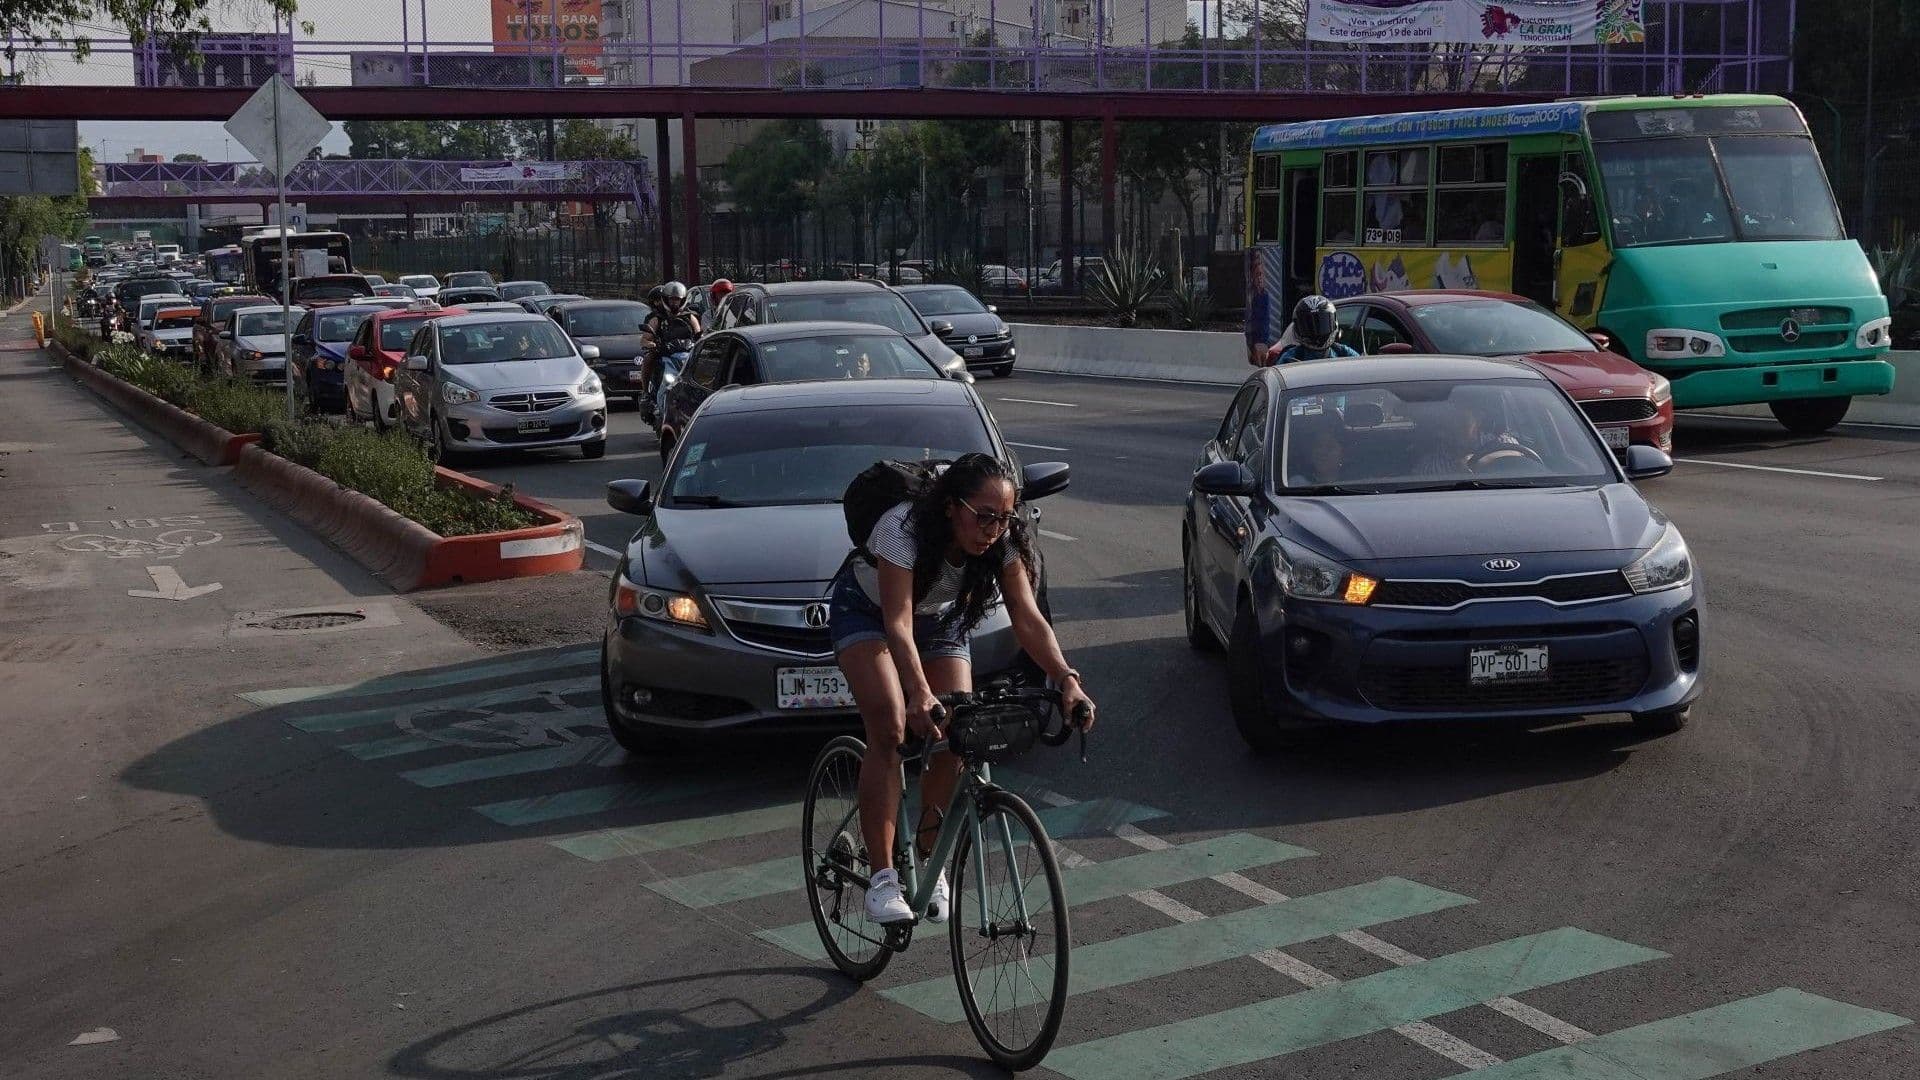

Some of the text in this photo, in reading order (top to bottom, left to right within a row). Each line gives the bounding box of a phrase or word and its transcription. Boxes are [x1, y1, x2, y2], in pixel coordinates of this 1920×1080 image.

[562, 14, 598, 24] PARA
[507, 23, 599, 40] TODOS
[1330, 27, 1432, 38] Este domingo 19 de abril
[1520, 24, 1572, 34] LA GRAN
[1454, 116, 1476, 129] PRICE
[1480, 114, 1507, 127] SHOES
[1507, 108, 1560, 127] KangaROOS
[1322, 255, 1363, 278] Price
[1489, 559, 1515, 568] KIA
[1471, 652, 1547, 673] PVP-601-C
[780, 677, 846, 696] LJN-753-
